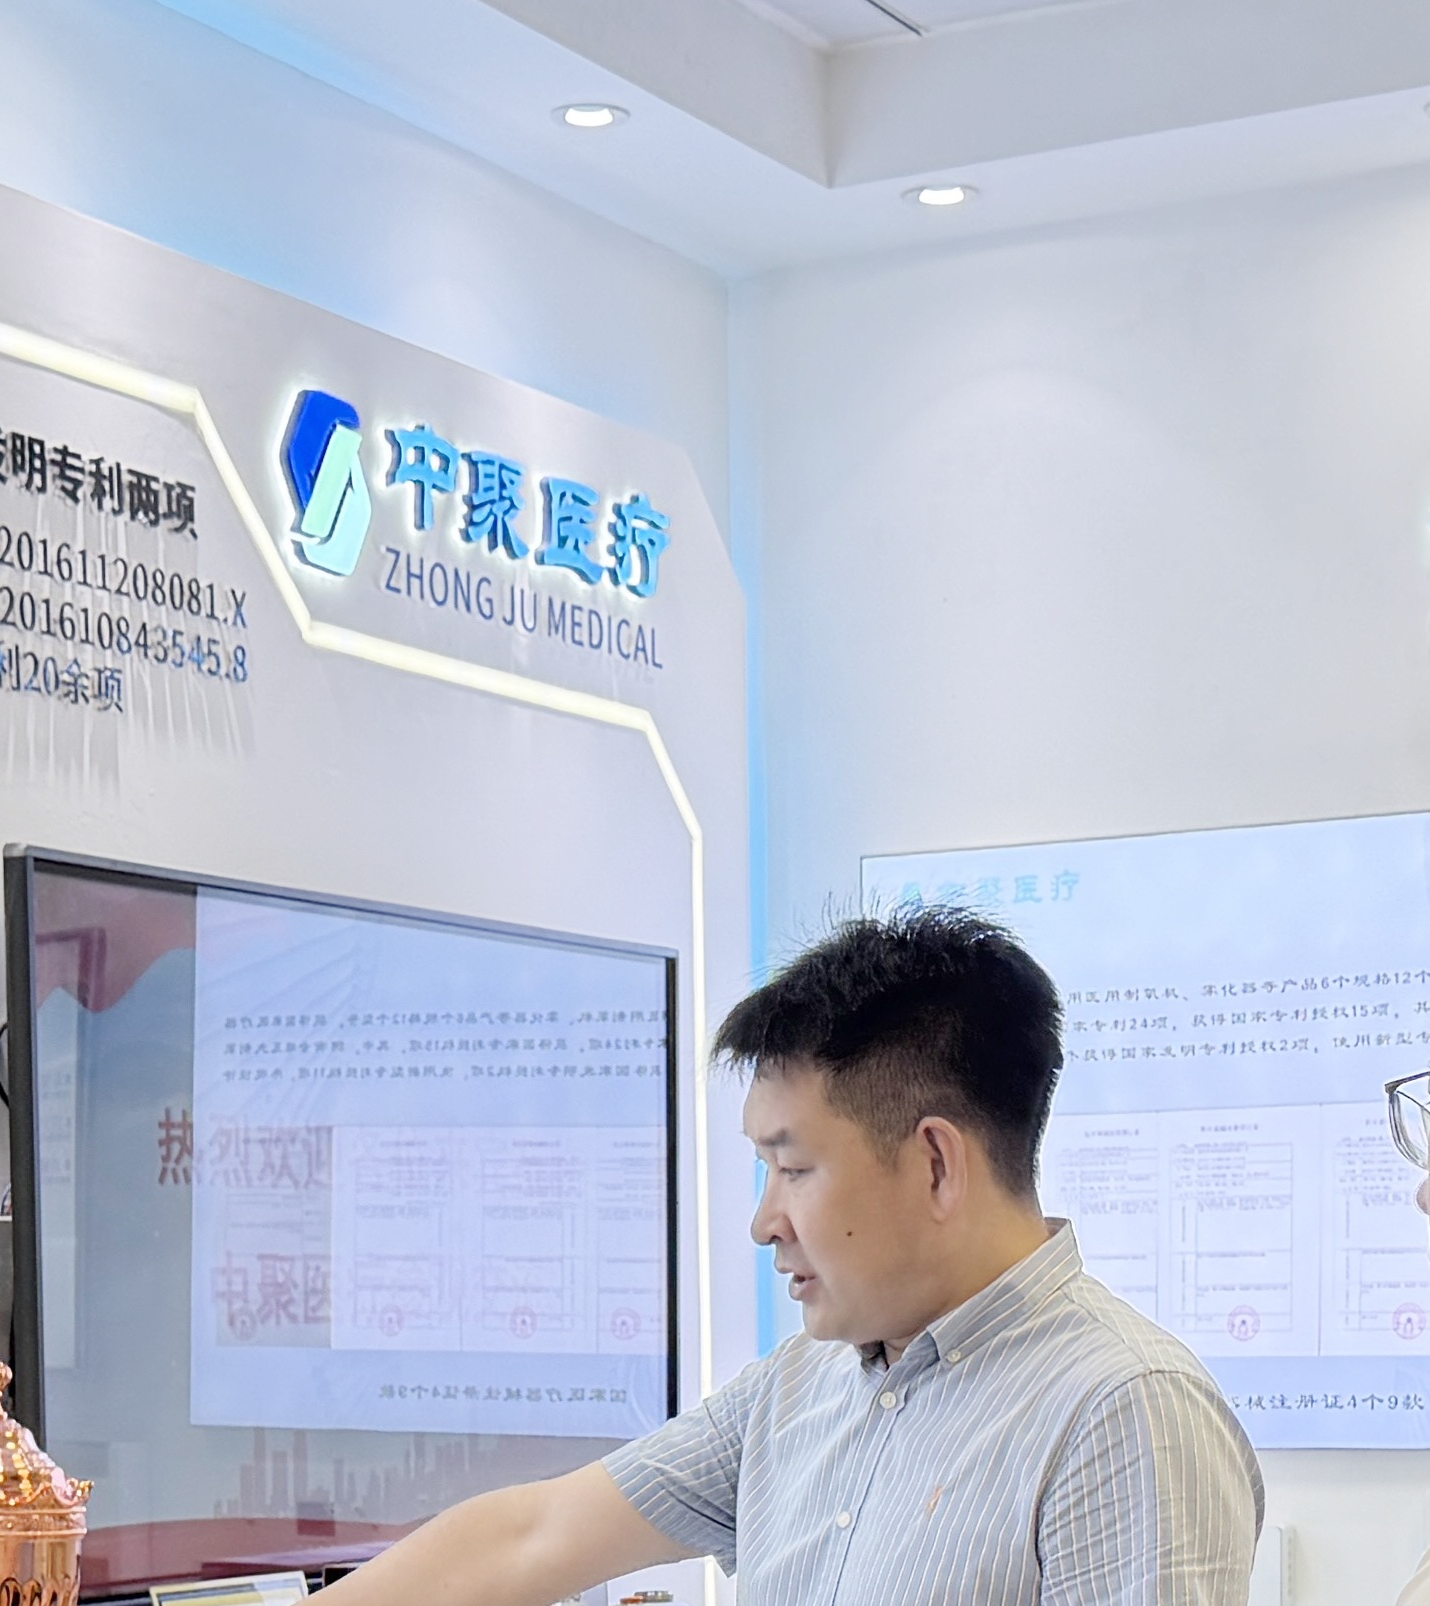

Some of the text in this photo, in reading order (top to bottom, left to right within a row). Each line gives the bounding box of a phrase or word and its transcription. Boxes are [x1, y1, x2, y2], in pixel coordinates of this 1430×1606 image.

[385, 425, 671, 598] 中聚医疗
[385, 547, 663, 670] ZHONG JU MEDICAL
